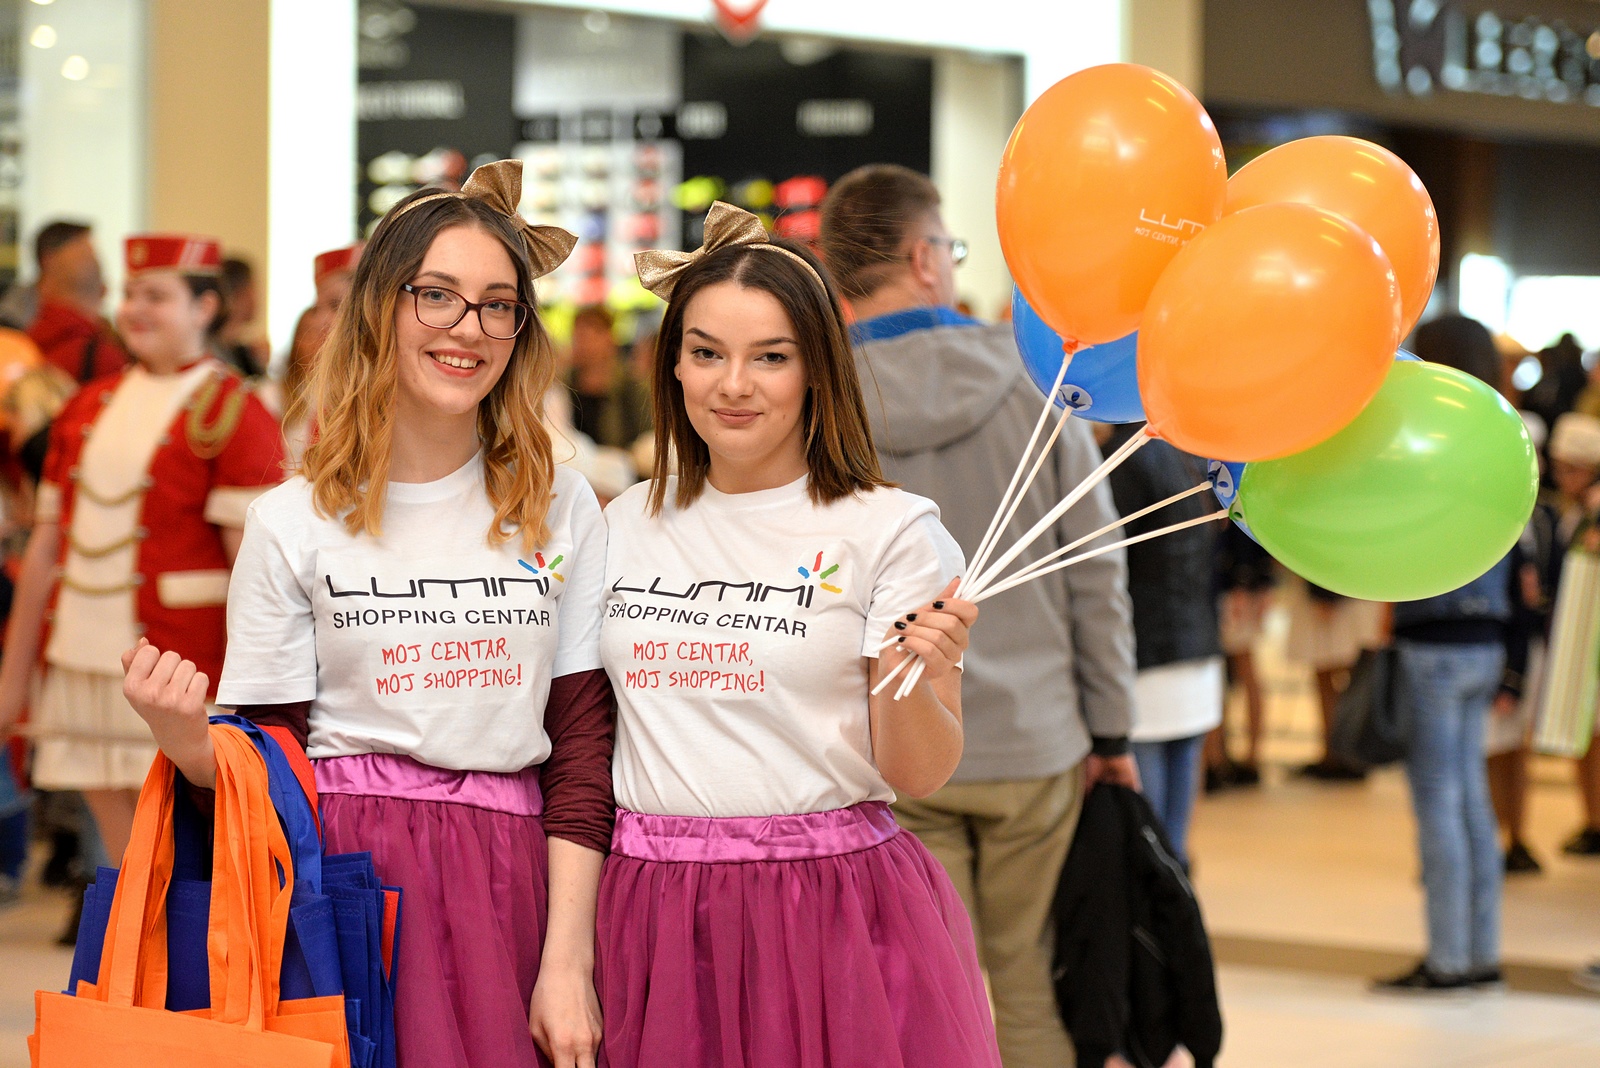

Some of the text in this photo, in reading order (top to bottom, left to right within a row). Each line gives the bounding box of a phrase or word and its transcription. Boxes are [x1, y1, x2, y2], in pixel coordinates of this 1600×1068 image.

[1139, 208, 1206, 234] LUM
[326, 574, 549, 598] LUMINI
[611, 576, 814, 608] LUMINI
[333, 609, 550, 629] SHOPPING CENTAR
[609, 602, 807, 638] SHOPPING CENTAR
[381, 637, 511, 666] MOJ CENTAR,
[633, 640, 754, 666] MOJ CENTAR,
[376, 663, 522, 695] MOJ SHOPPING!
[625, 669, 765, 693] MOJ SHOPPING!
